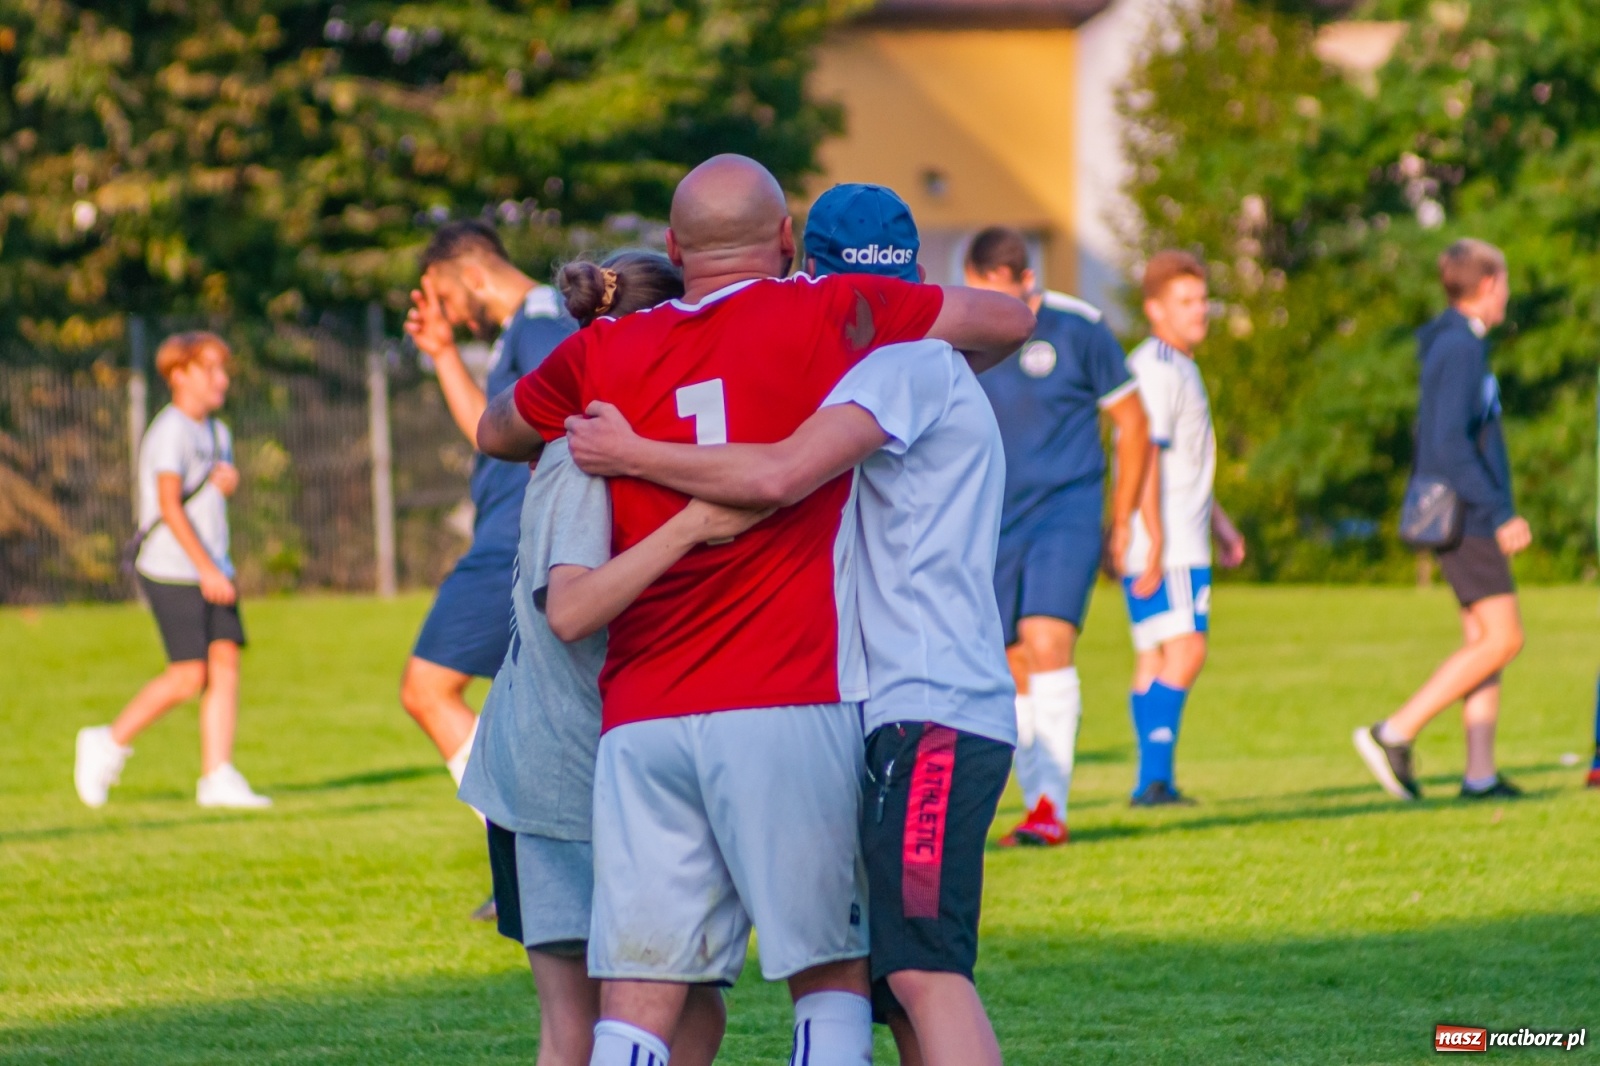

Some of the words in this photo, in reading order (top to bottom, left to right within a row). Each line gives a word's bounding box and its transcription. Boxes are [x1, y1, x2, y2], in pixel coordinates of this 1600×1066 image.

[842, 244, 913, 265] adidas
[675, 377, 727, 446] 1
[915, 761, 945, 856] ATHLETIC
